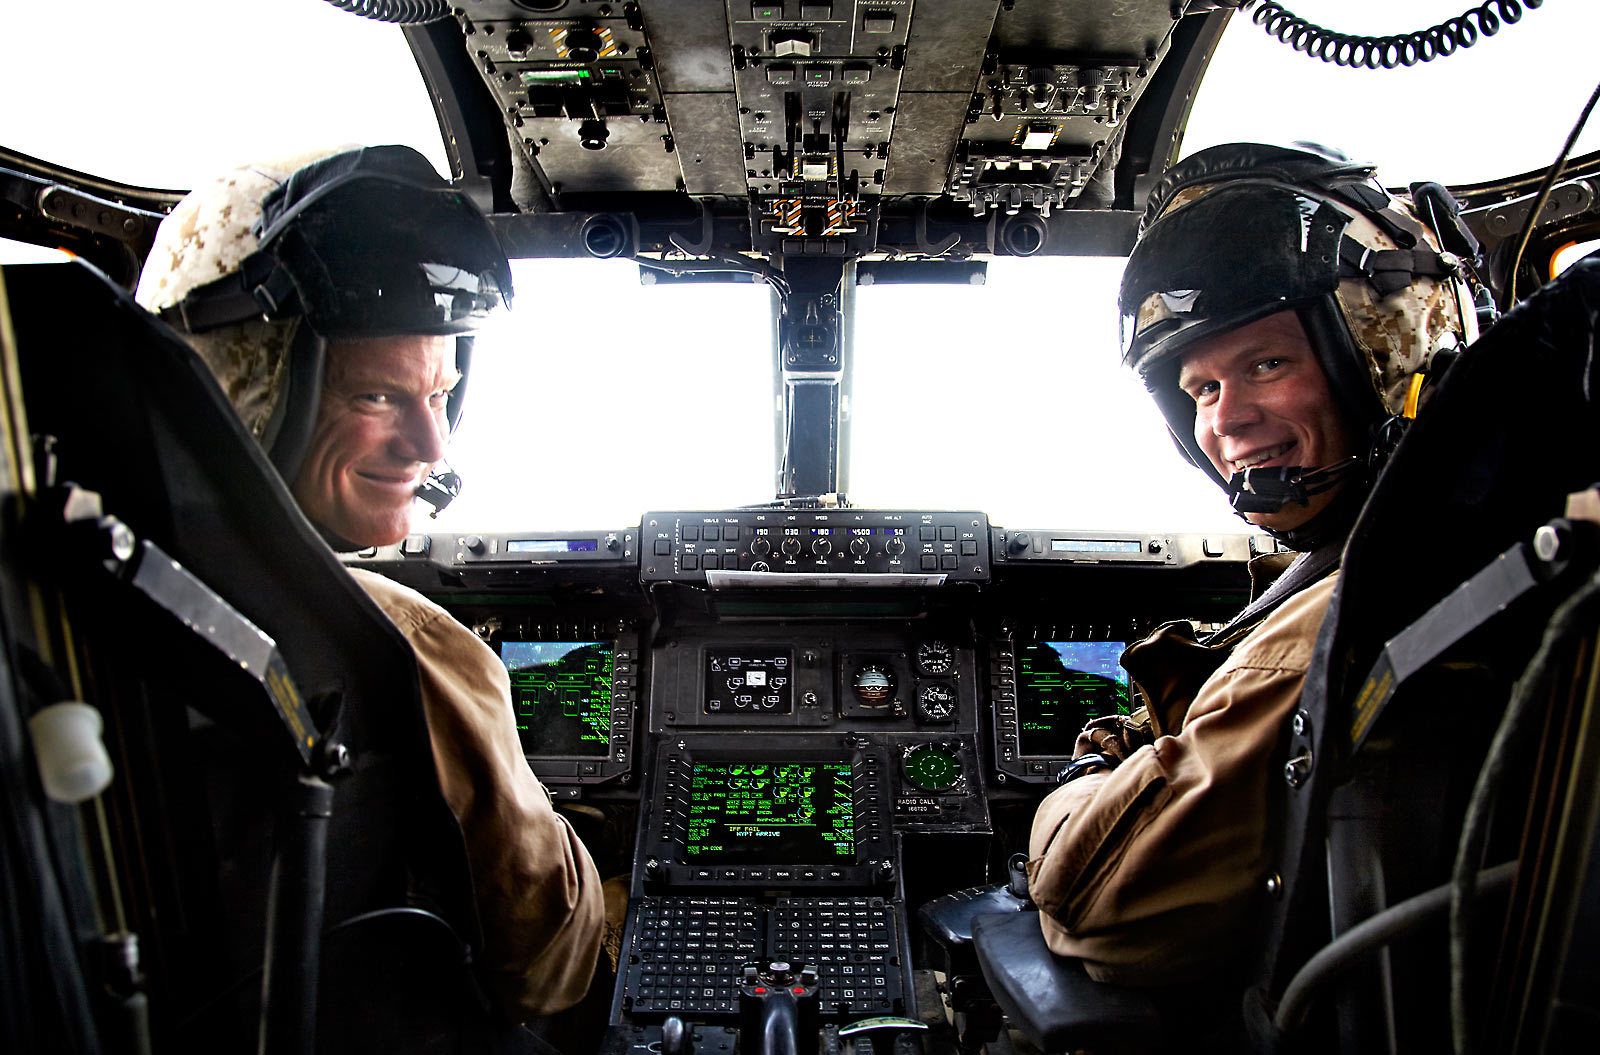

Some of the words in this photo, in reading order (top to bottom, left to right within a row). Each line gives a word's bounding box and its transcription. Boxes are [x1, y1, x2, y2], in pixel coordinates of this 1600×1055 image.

[784, 528, 799, 536] 030
[817, 528, 829, 536] 180
[852, 528, 870, 536] 4500
[894, 528, 904, 536] 50
